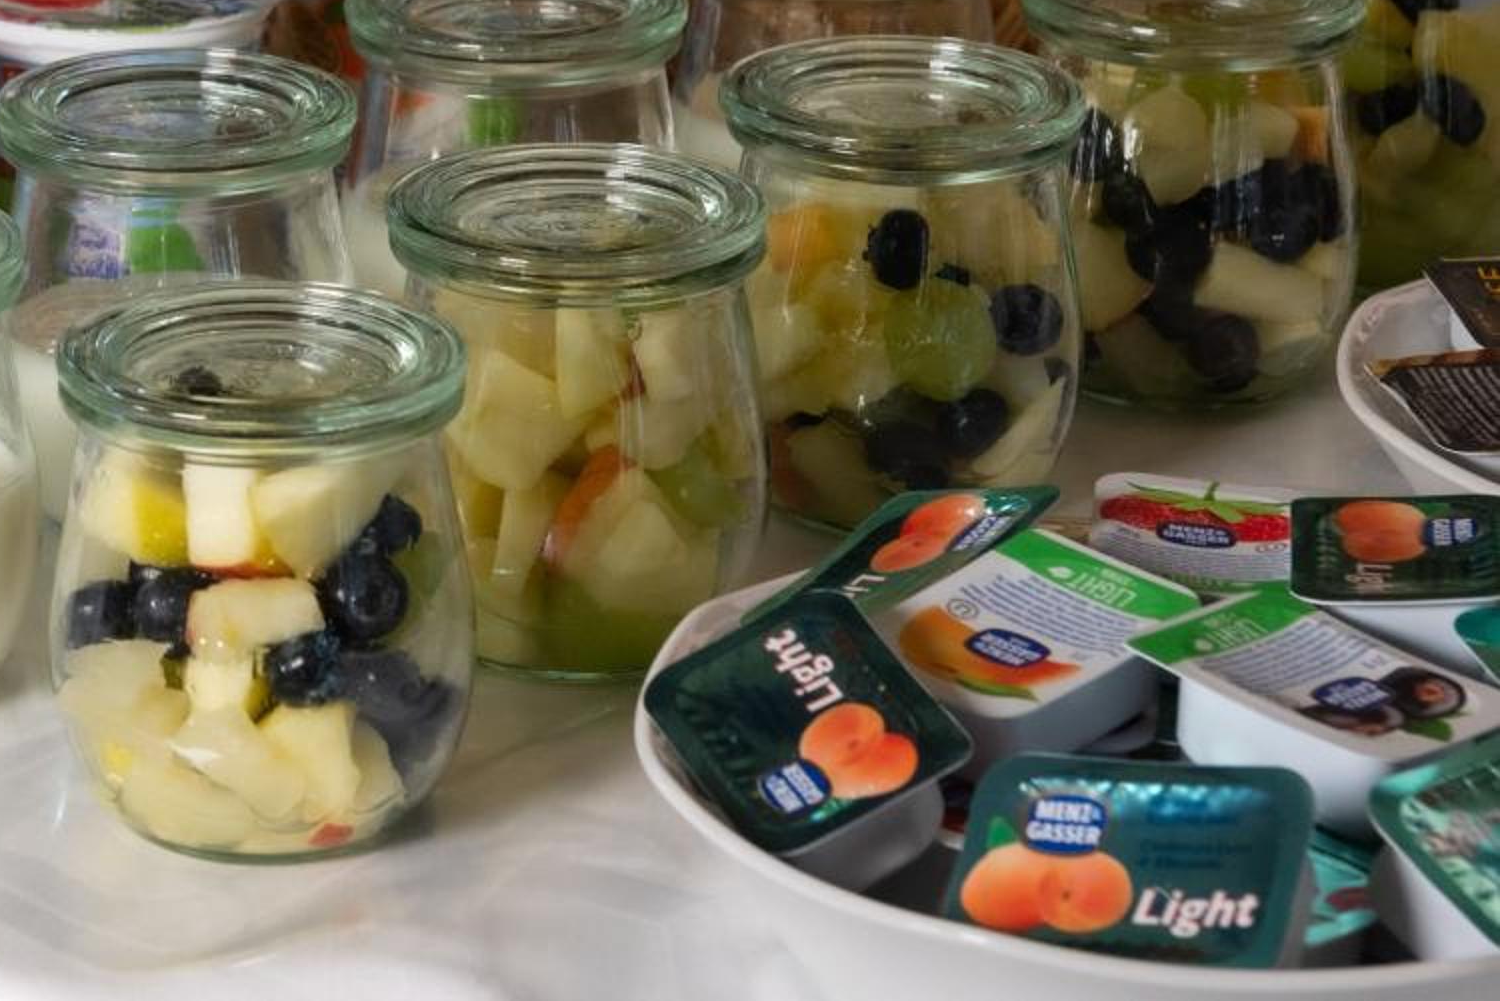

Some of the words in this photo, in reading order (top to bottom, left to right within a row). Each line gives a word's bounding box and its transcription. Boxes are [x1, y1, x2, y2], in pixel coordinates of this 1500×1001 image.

[764, 628, 844, 713] Light
[1026, 821, 1102, 846] GASSER
[1132, 887, 1259, 937] Light
